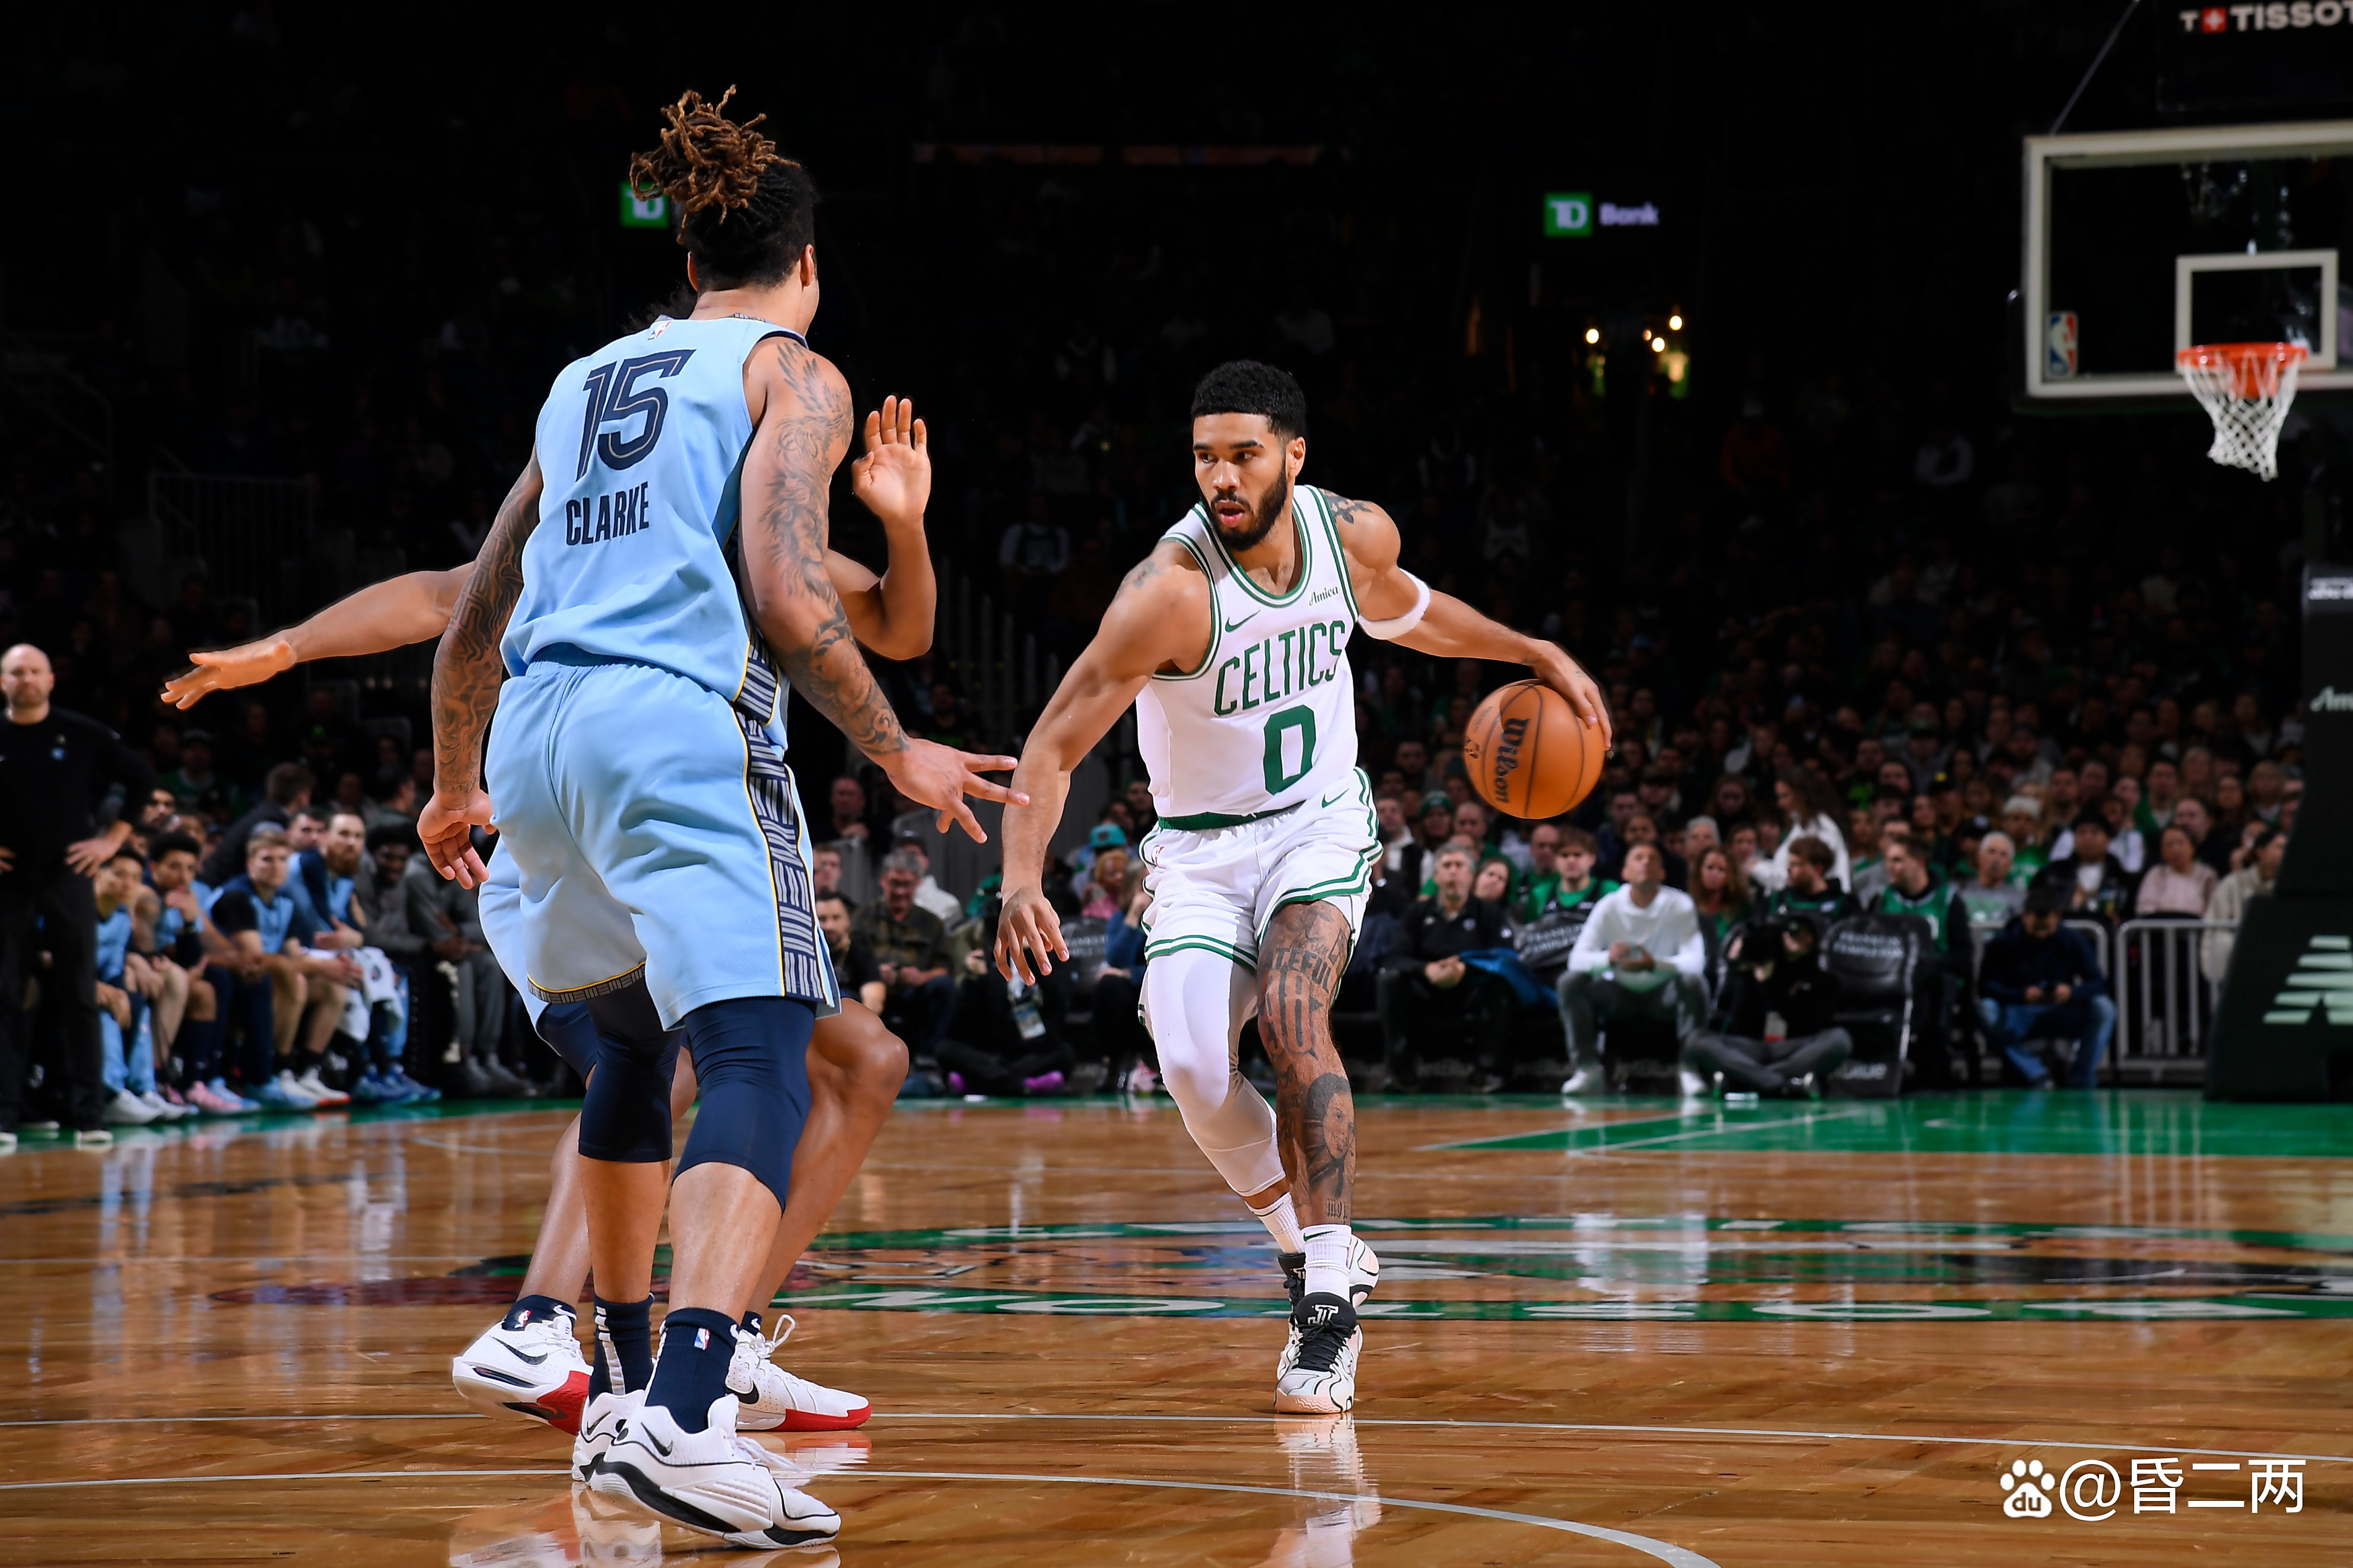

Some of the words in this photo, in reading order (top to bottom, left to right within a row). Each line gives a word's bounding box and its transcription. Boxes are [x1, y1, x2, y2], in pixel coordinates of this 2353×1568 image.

[1548, 200, 1588, 230] TD
[1598, 201, 1660, 227] Bank
[575, 349, 697, 482] 15
[566, 481, 649, 546] CLARKE
[1309, 587, 1338, 606] Amica
[1214, 621, 1346, 716] CELTICS
[1263, 704, 1317, 795] 0
[1494, 717, 1531, 803] Wilson
